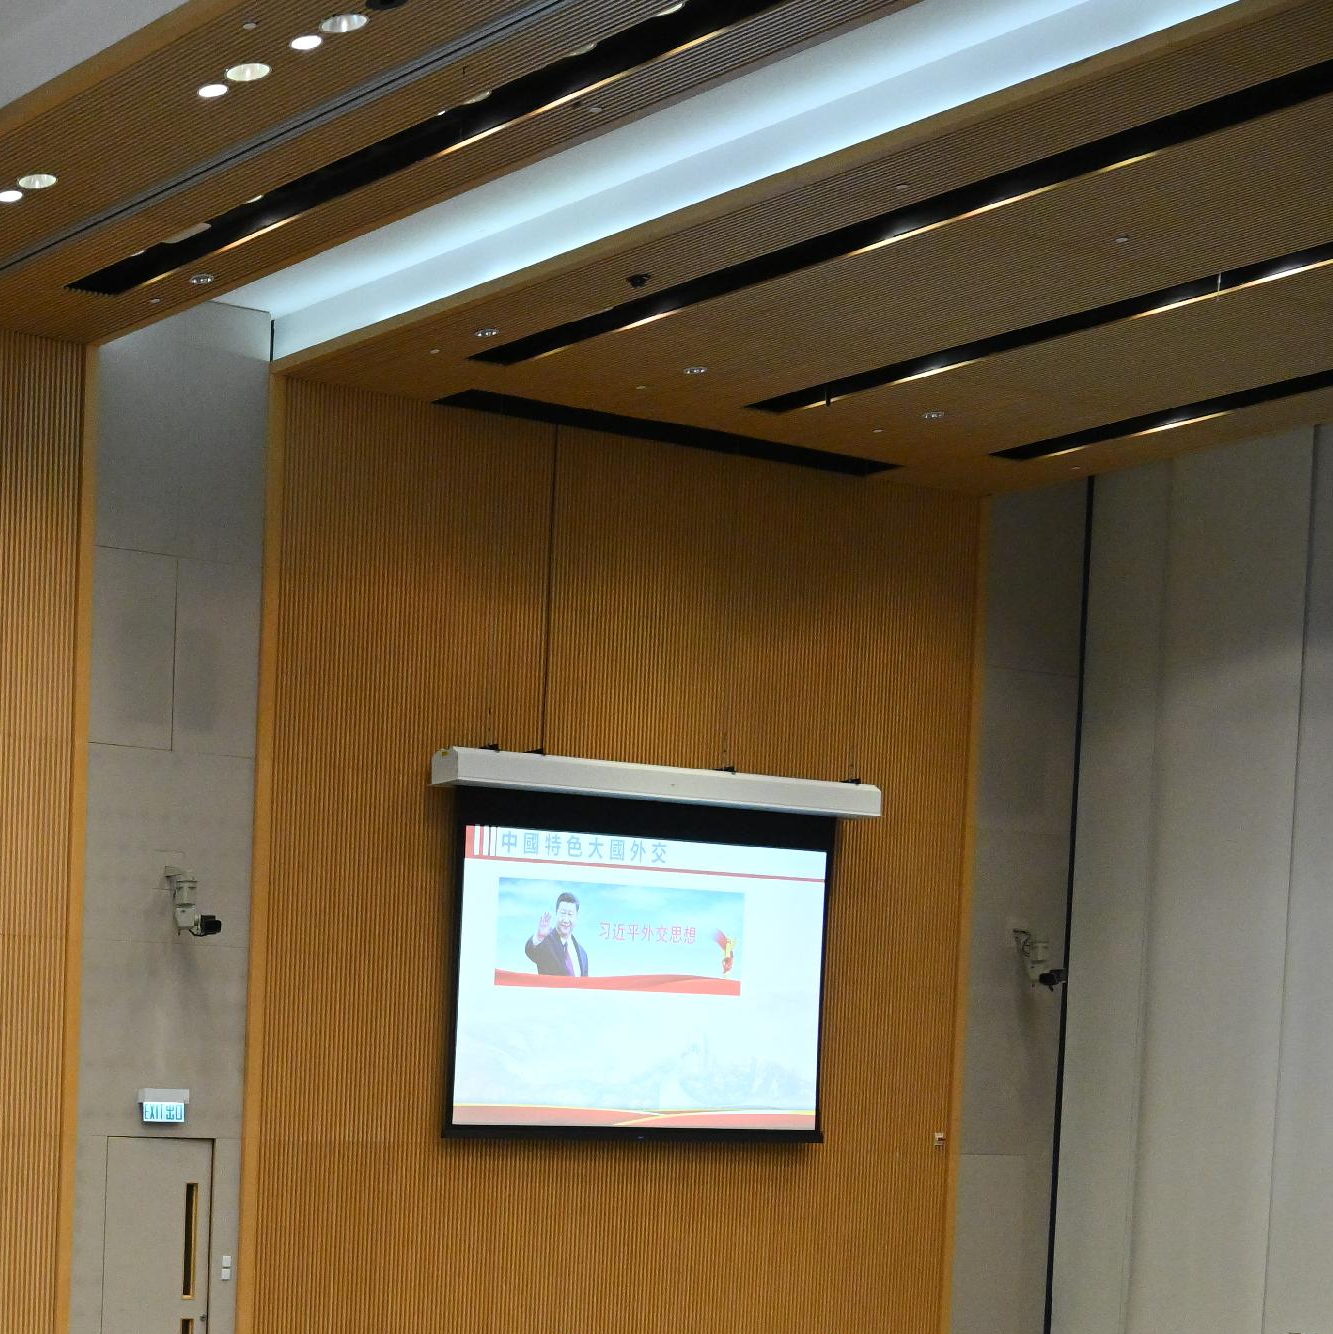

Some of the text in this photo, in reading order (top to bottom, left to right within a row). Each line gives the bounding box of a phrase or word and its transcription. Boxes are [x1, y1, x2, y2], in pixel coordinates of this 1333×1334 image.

[501, 831, 667, 864] 中國特色大國外交
[598, 922, 696, 944] 习近平外交思想
[144, 1103, 182, 1120] EXIT 出口
